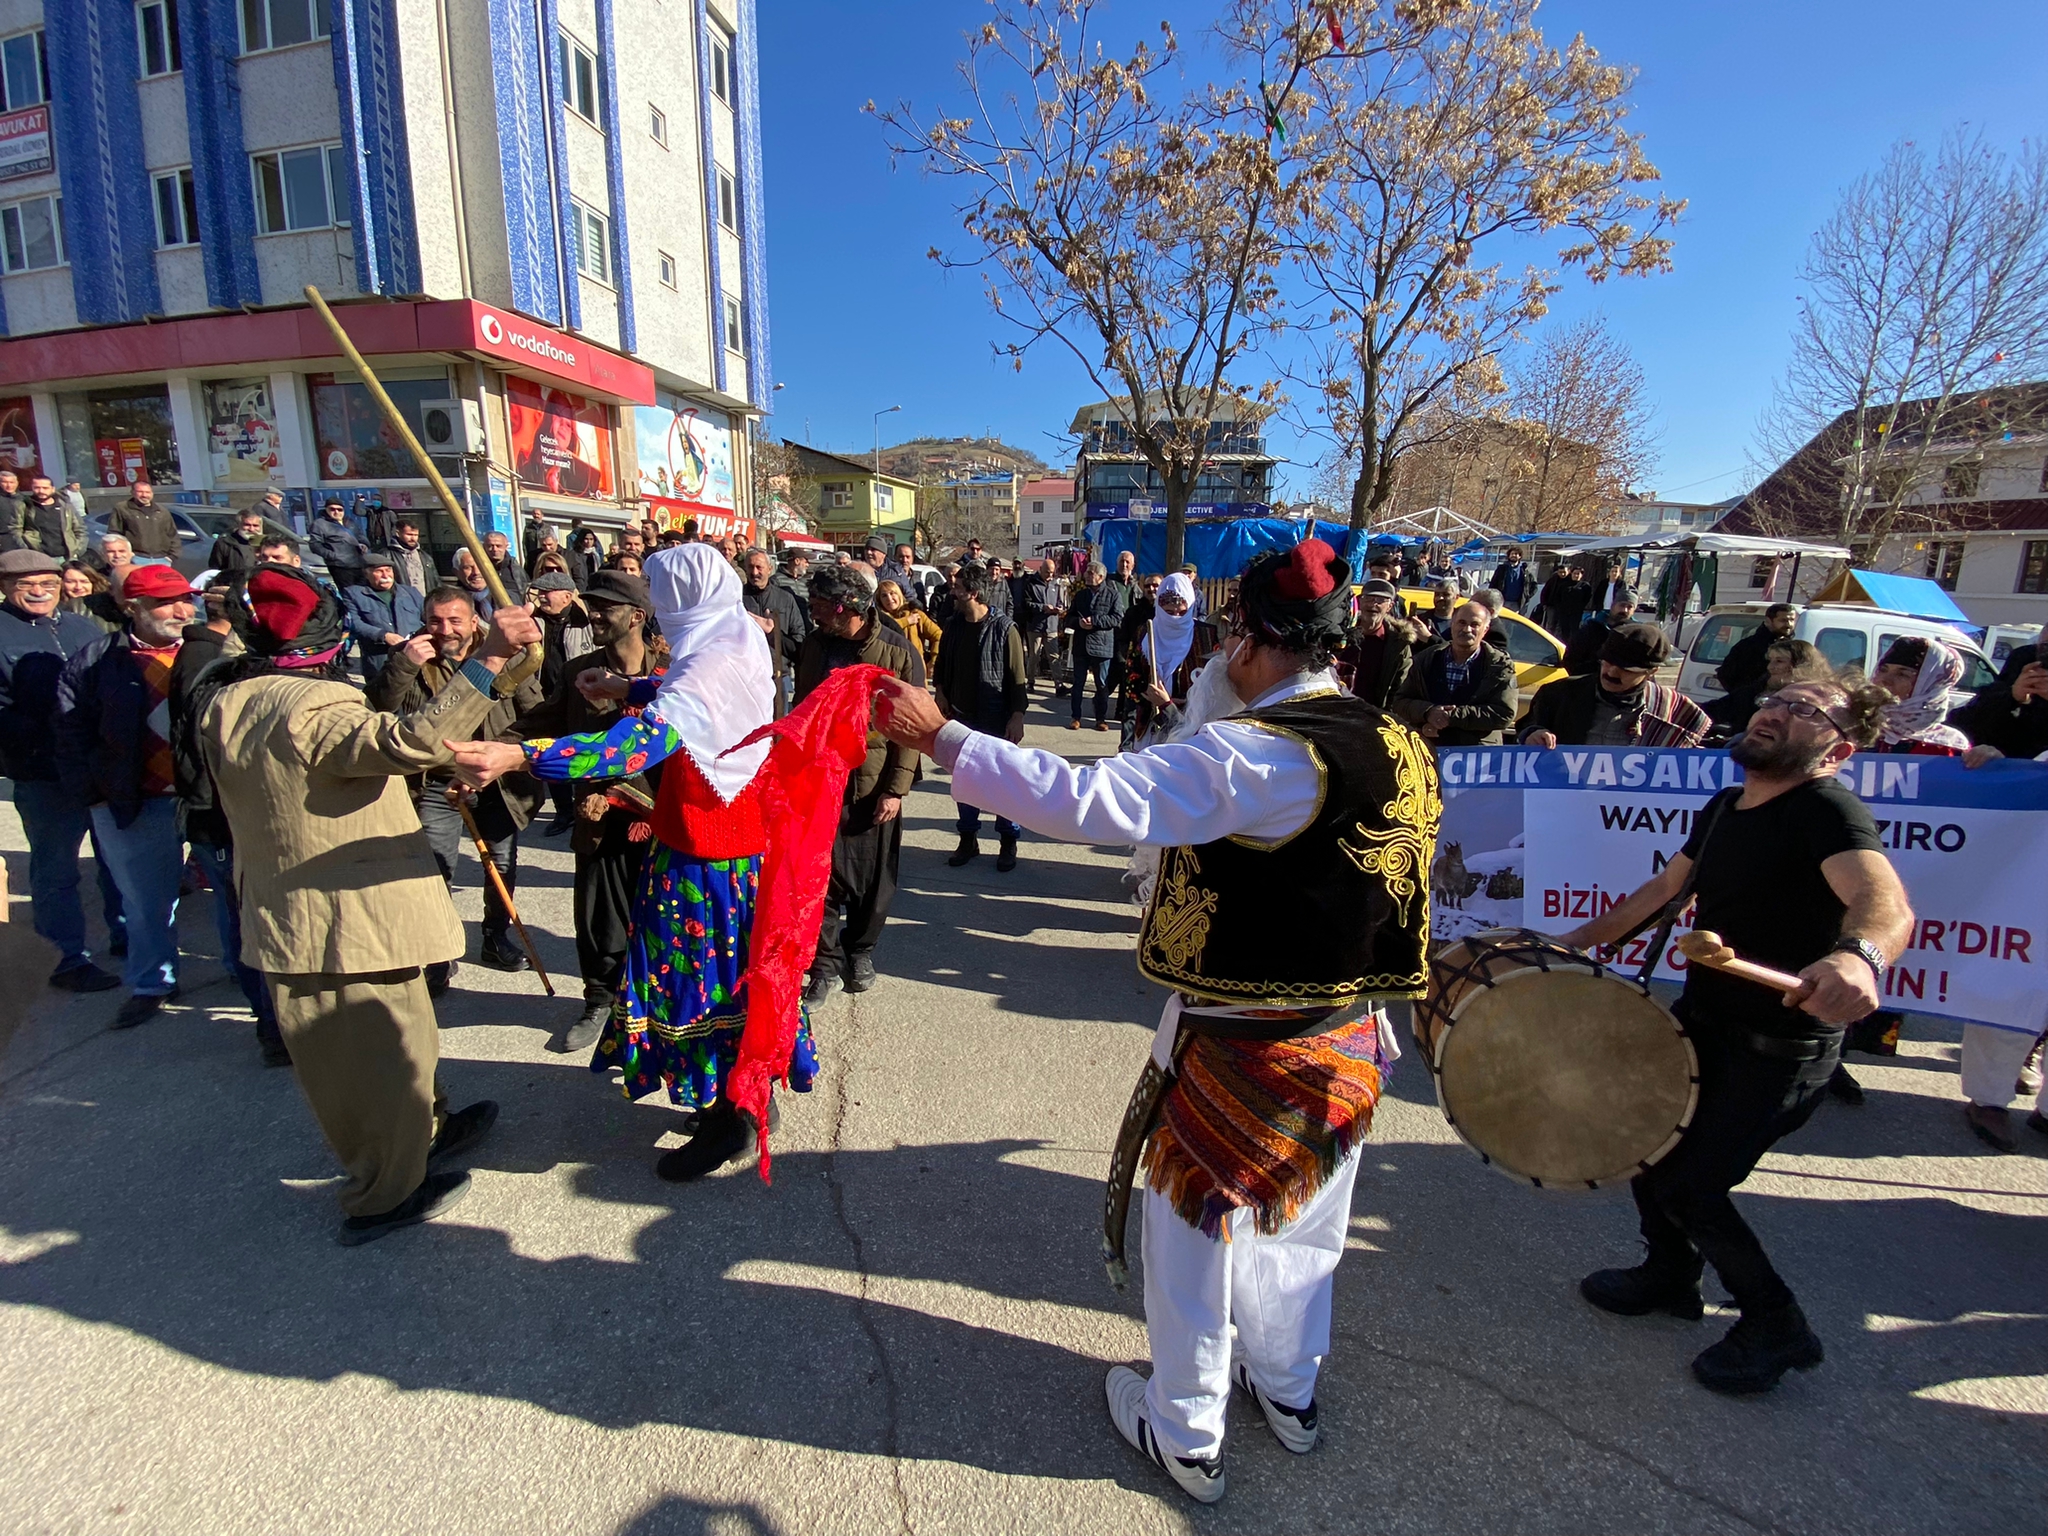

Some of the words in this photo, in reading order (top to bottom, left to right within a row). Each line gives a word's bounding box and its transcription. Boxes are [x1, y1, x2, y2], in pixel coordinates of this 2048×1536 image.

[0, 114, 42, 136] AVUKAT
[507, 330, 576, 367] vodafone
[1184, 506, 1213, 514] LECTIVE
[1438, 752, 1540, 784] CILIK
[1563, 752, 1920, 799] YASAKLSIN
[1875, 820, 1966, 852] ZIRO
[1544, 882, 1627, 918] BİZİM
